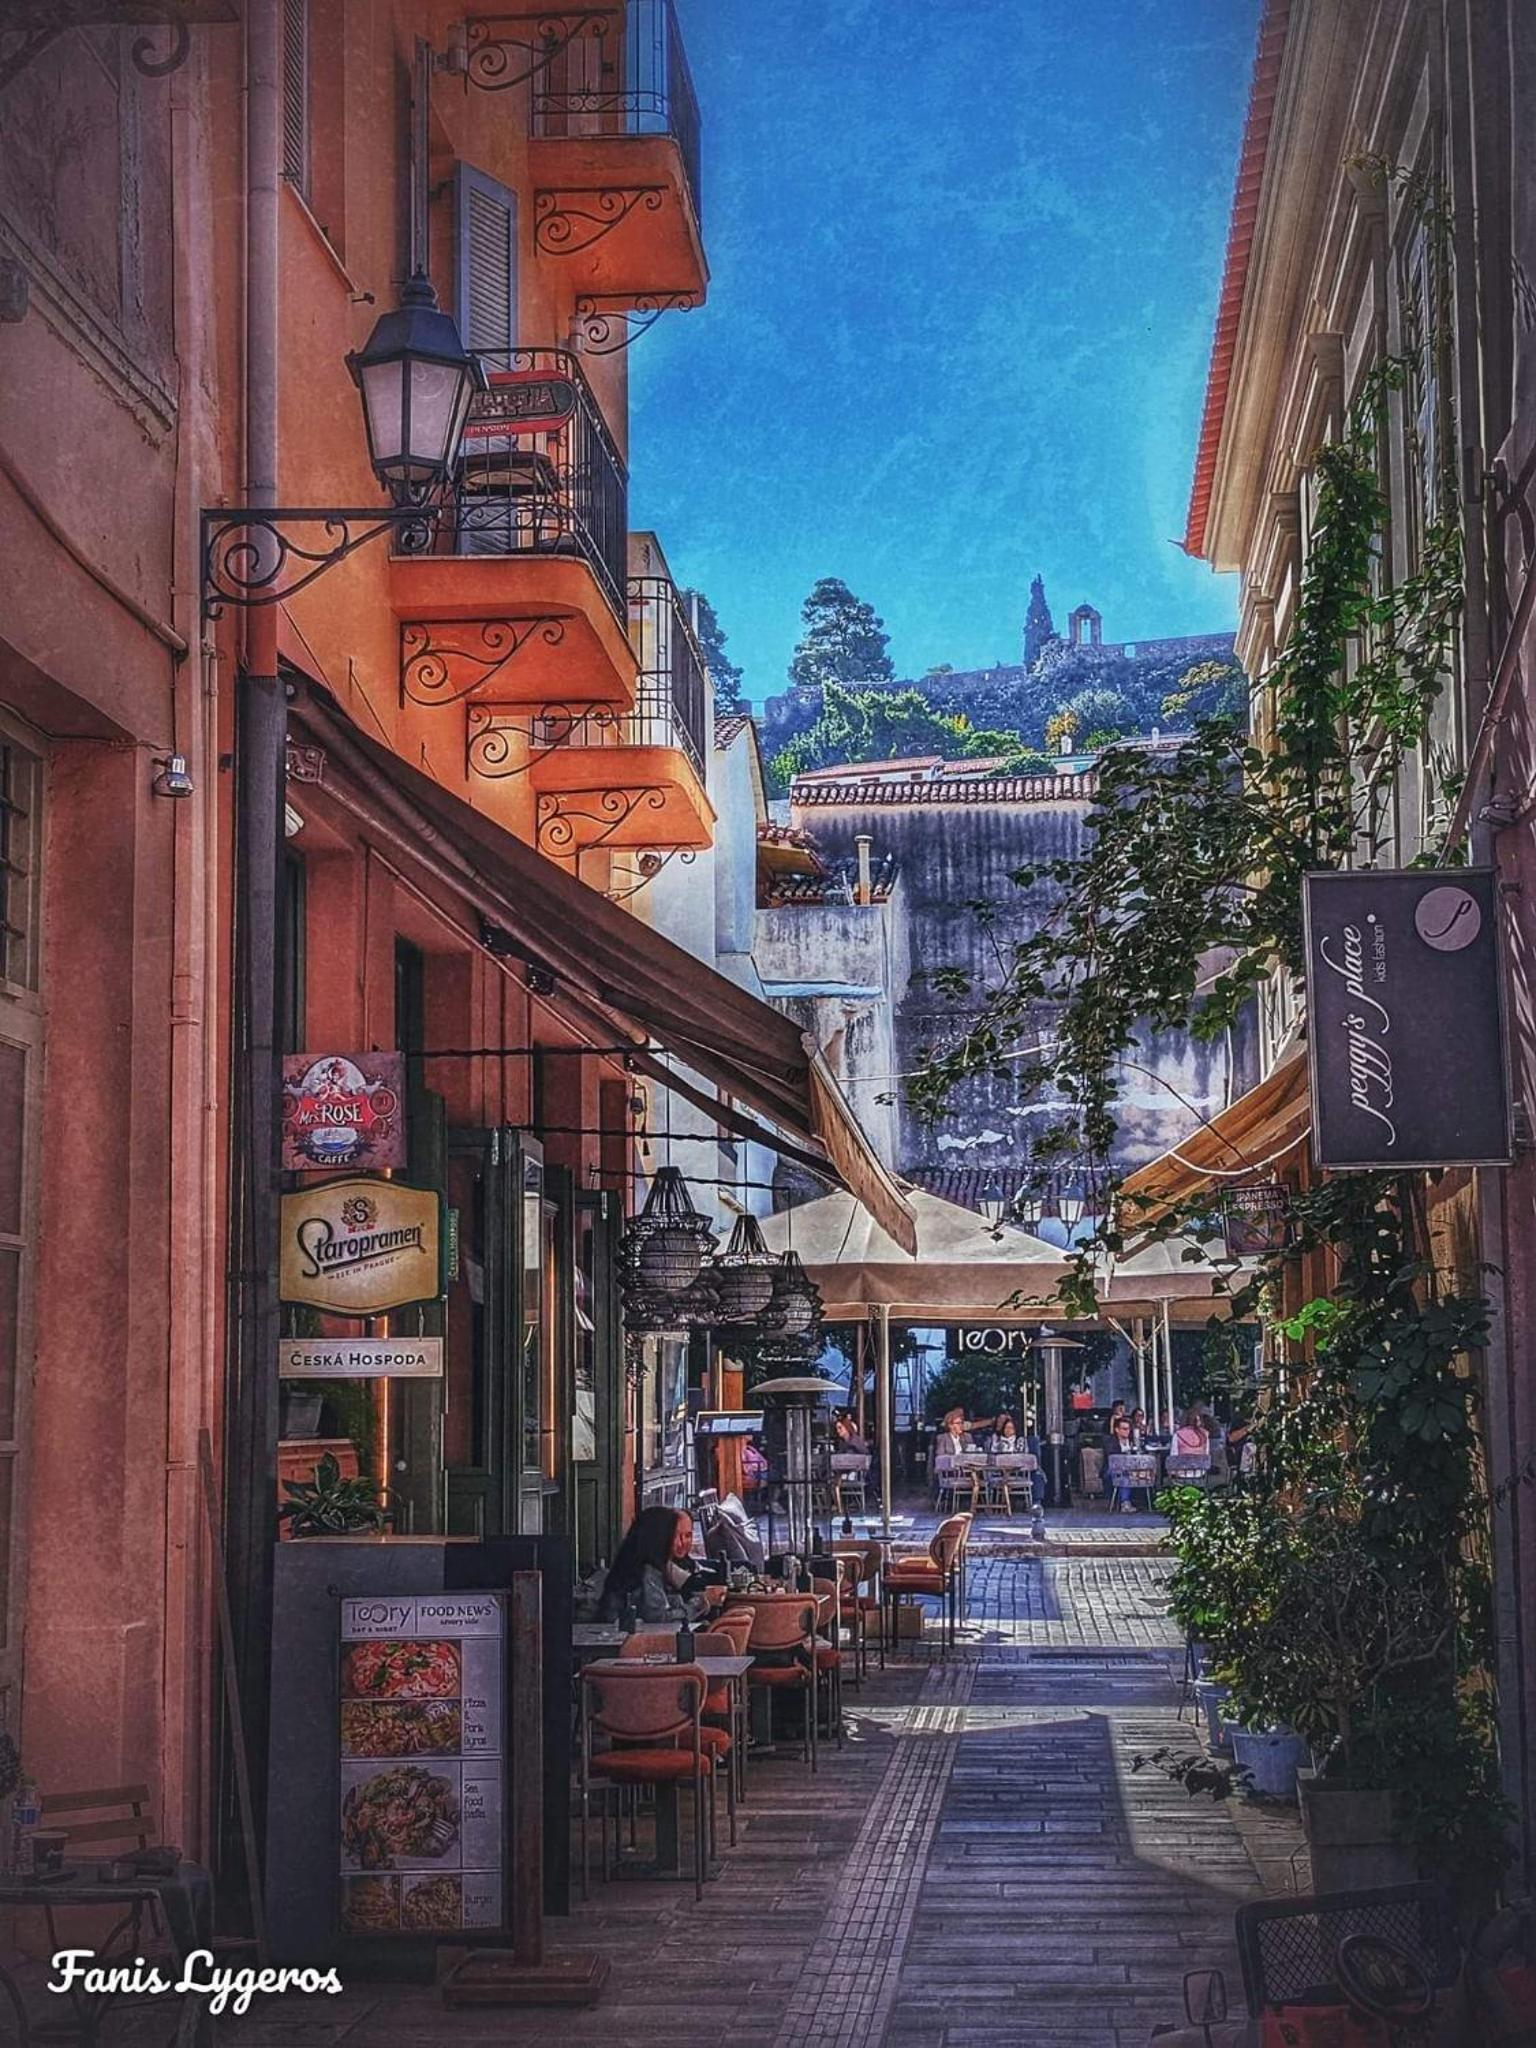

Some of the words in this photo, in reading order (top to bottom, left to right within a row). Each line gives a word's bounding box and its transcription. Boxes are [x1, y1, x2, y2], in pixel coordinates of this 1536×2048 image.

[1373, 924, 1386, 957] fashion
[1320, 924, 1390, 1034] place
[1374, 959, 1387, 983] kids
[1341, 1013, 1396, 1146] peggy's
[314, 1101, 363, 1126] ROSE
[1236, 1190, 1279, 1202] IPANEMA
[297, 1217, 427, 1279] Staropramen
[290, 1351, 343, 1366] ČESKÁ
[350, 1352, 426, 1366] HOSPODA
[421, 1606, 455, 1617] FOOD
[458, 1605, 492, 1617] NEWS
